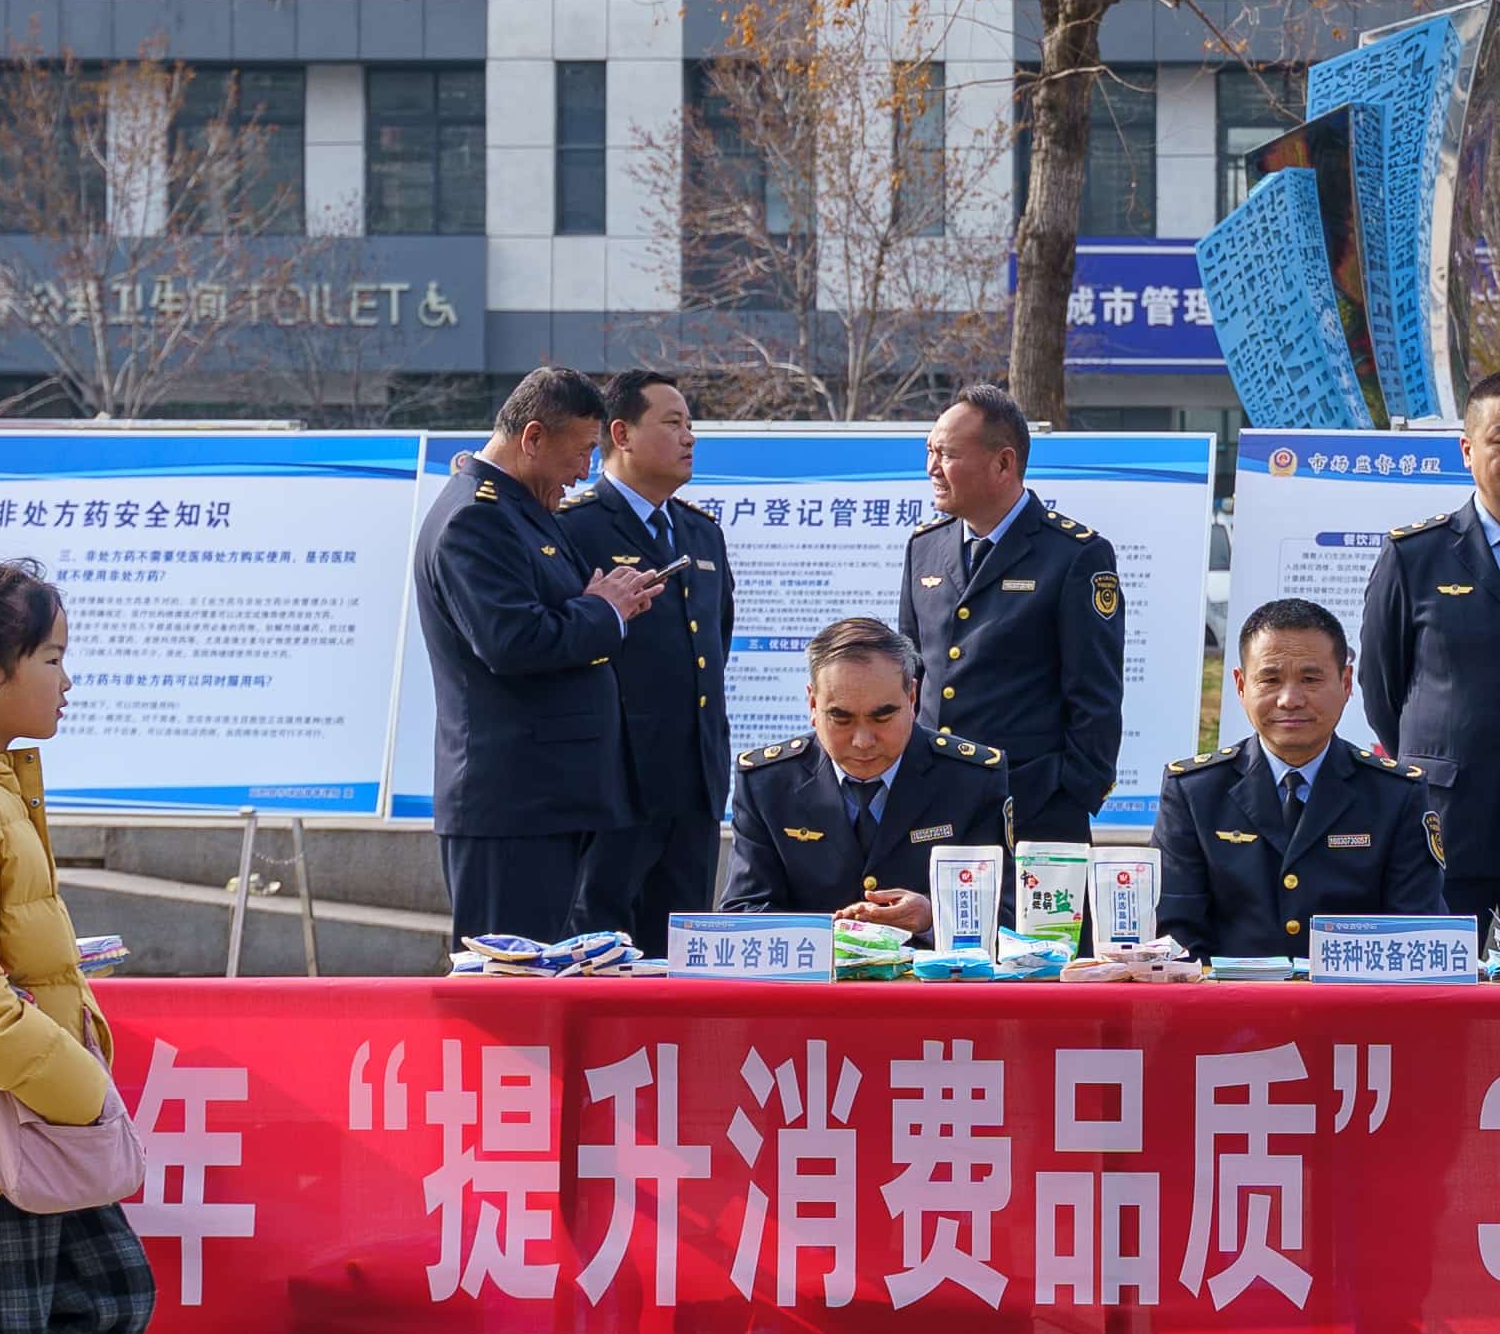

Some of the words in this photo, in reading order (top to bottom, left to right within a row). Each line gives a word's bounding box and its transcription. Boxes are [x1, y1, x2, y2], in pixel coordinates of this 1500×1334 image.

[244, 281, 411, 327] TOILET
[1308, 452, 1442, 476] 市场监督管理
[1343, 534, 1388, 547] 餐饮消
[686, 937, 817, 969] 盐业咨询台
[1321, 938, 1469, 973] 特种设备咨询台
[349, 1039, 1392, 1311] “提升消费品质”
